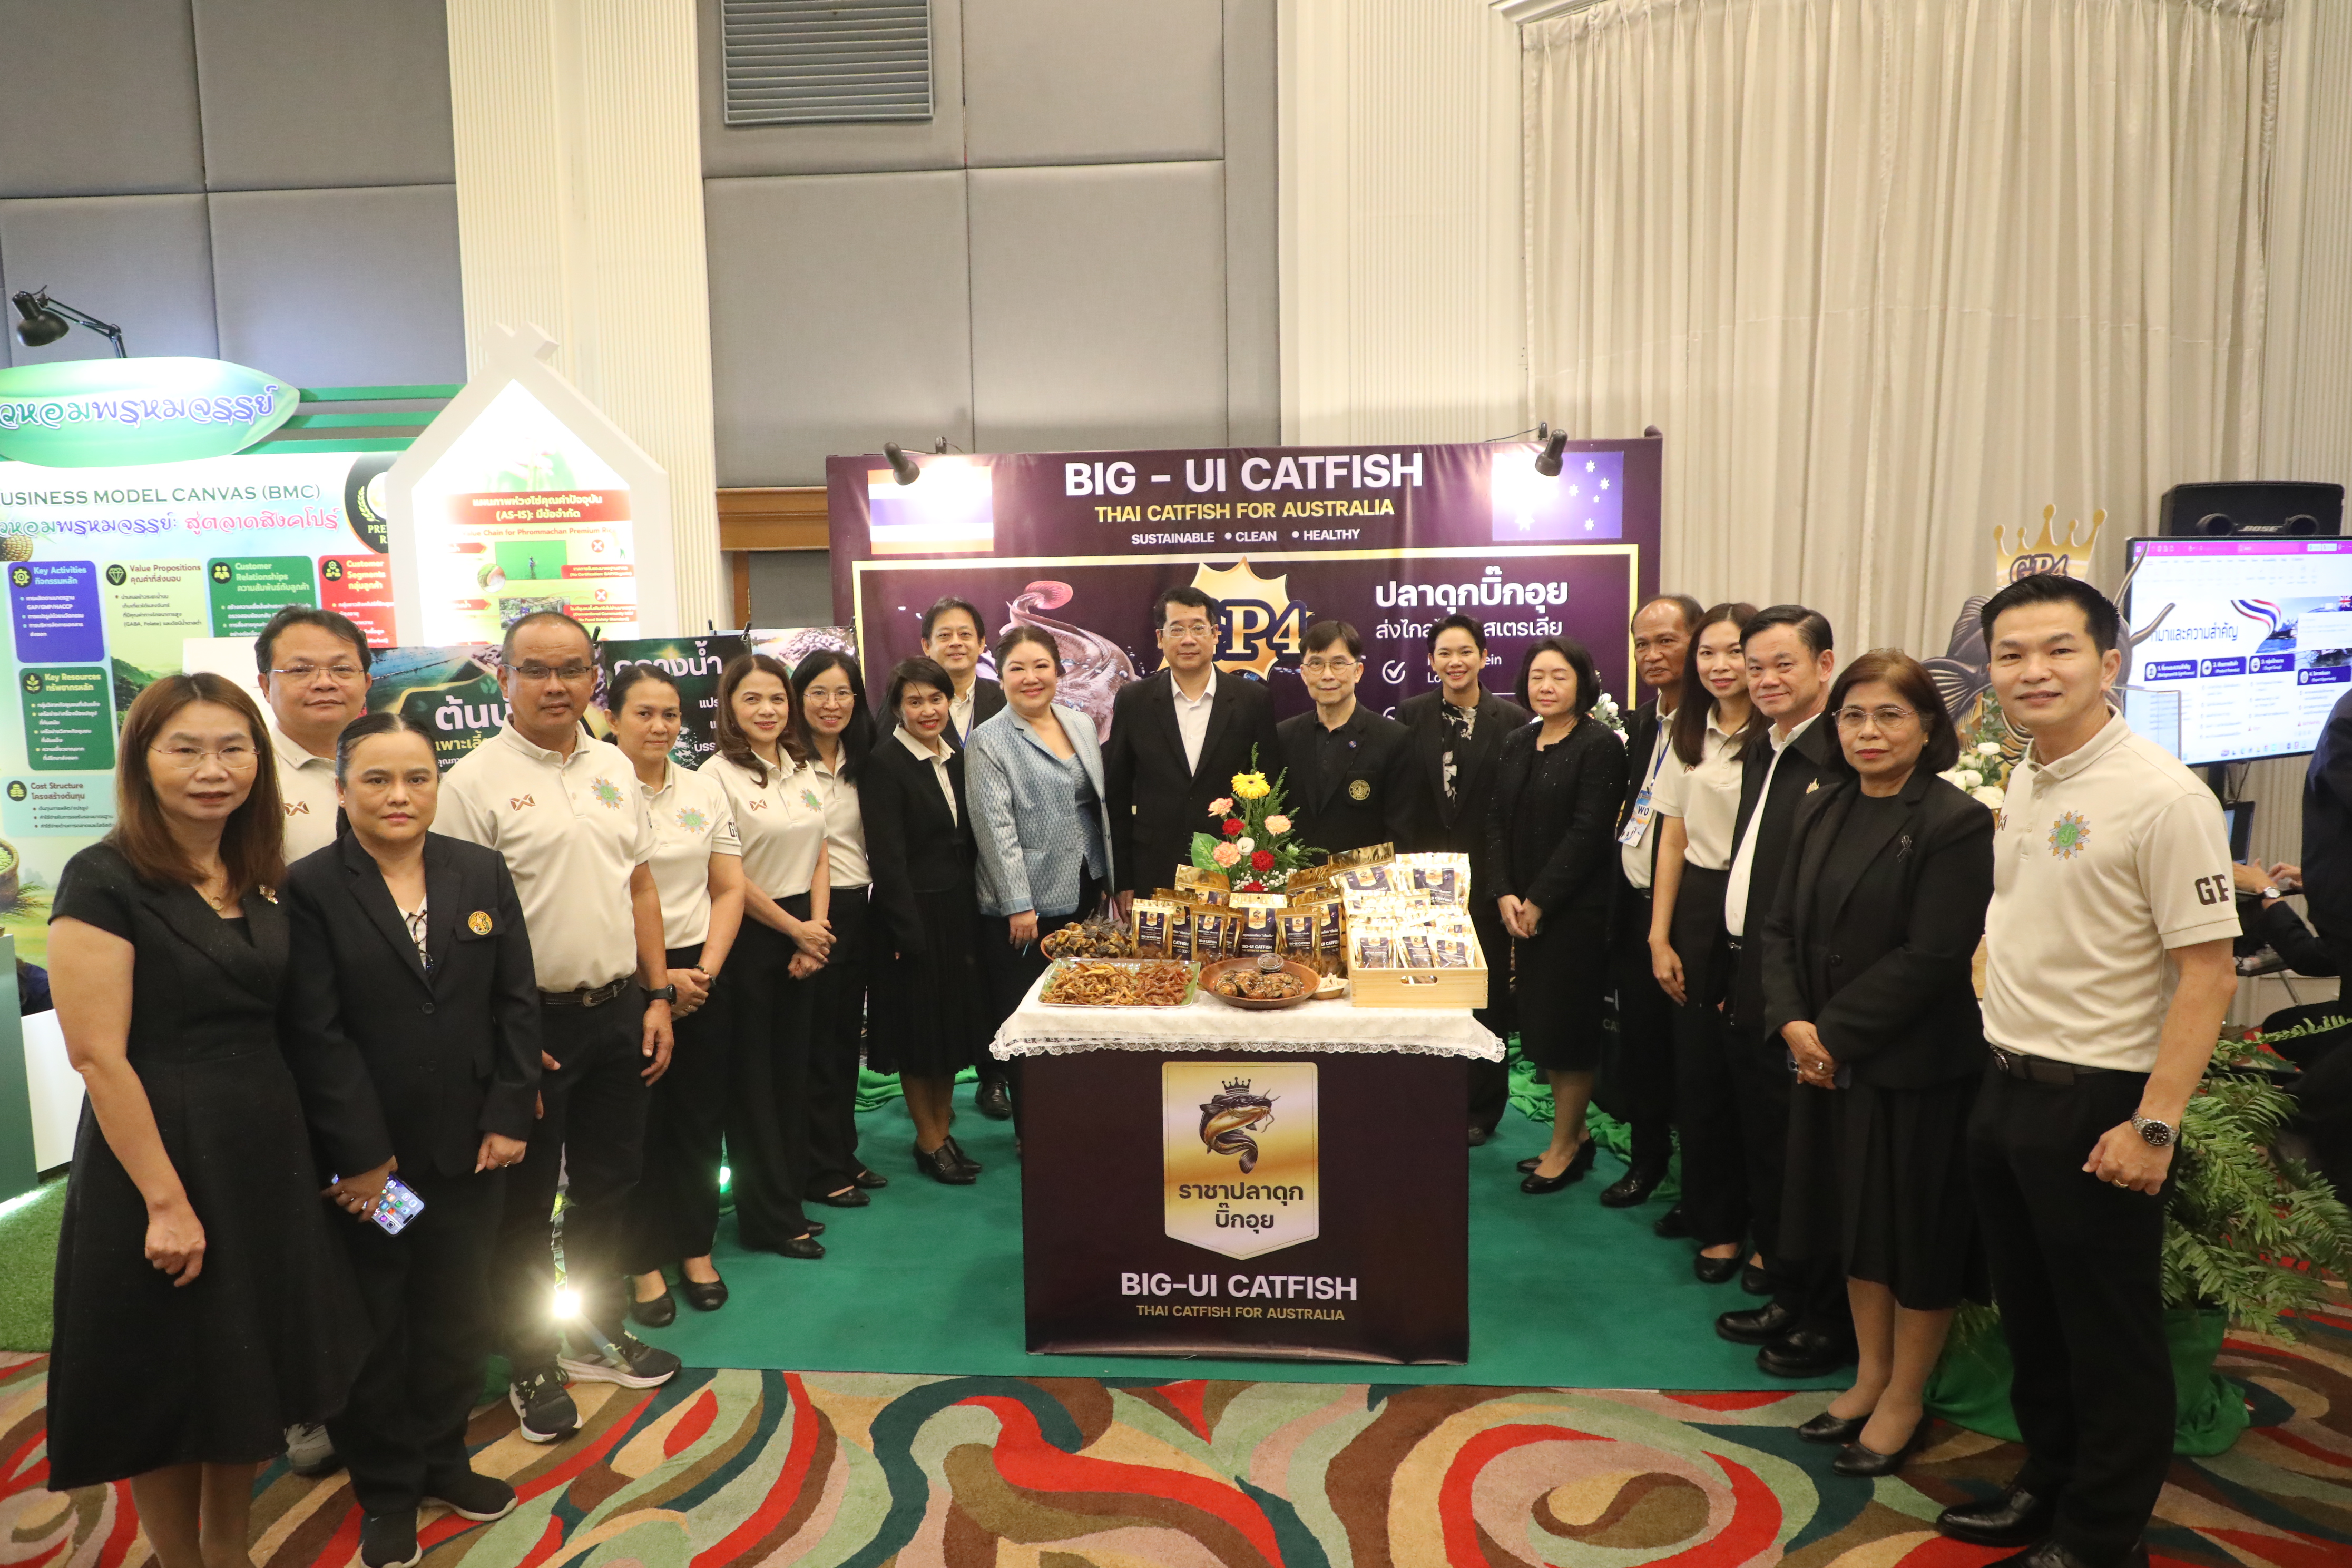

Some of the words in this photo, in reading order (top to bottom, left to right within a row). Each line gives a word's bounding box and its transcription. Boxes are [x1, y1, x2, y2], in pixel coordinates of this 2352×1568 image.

[1065, 461, 1136, 496] BIG
[1186, 458, 1227, 492] UI
[1241, 452, 1423, 492] CATFISH
[0, 490, 88, 505] USINESS
[94, 489, 167, 503] MODEL
[172, 486, 257, 502] CANVAS
[263, 484, 320, 500] (BMC)
[496, 510, 533, 521] (AS-IS):
[1095, 506, 1141, 523] THAI
[1146, 503, 1230, 521] CATFISH
[1237, 502, 1276, 518] FOR
[1282, 499, 1395, 518] AUSTRALIA
[185, 506, 340, 534] สู่ตลาดสิงคโปร์
[2238, 523, 2283, 532] BOSE
[1131, 532, 1215, 545] SUSTAINABLE
[1235, 530, 1277, 543] CLEAN
[1303, 528, 1360, 541] HEALTHY
[33, 567, 49, 575] Key
[153, 564, 201, 573] Propositions
[347, 571, 386, 580] Segments
[35, 576, 78, 585] กิจกรรมหลัก
[130, 573, 181, 585] คุณค่าที่ส่งมอบ
[236, 572, 288, 581] Relationships
[348, 580, 383, 592] กลุ่มลูกค้า
[1376, 565, 1569, 614] ปลาดุกบิ๊กอุย
[1213, 606, 1302, 654] P4
[44, 673, 60, 682] Key
[31, 792, 85, 801] โครงสร้างต้นทุน
[1179, 1182, 1305, 1206] ราชาปลาดุก
[1214, 1203, 1275, 1234] บิ๊กอุย
[1121, 1272, 1217, 1297] BIG-UI
[1228, 1276, 1357, 1301] CATFISH
[1136, 1305, 1169, 1317] THAI
[1172, 1306, 1231, 1318] CATFISH
[1235, 1307, 1262, 1318] FOR
[1267, 1308, 1345, 1321] AUSTRALIA
